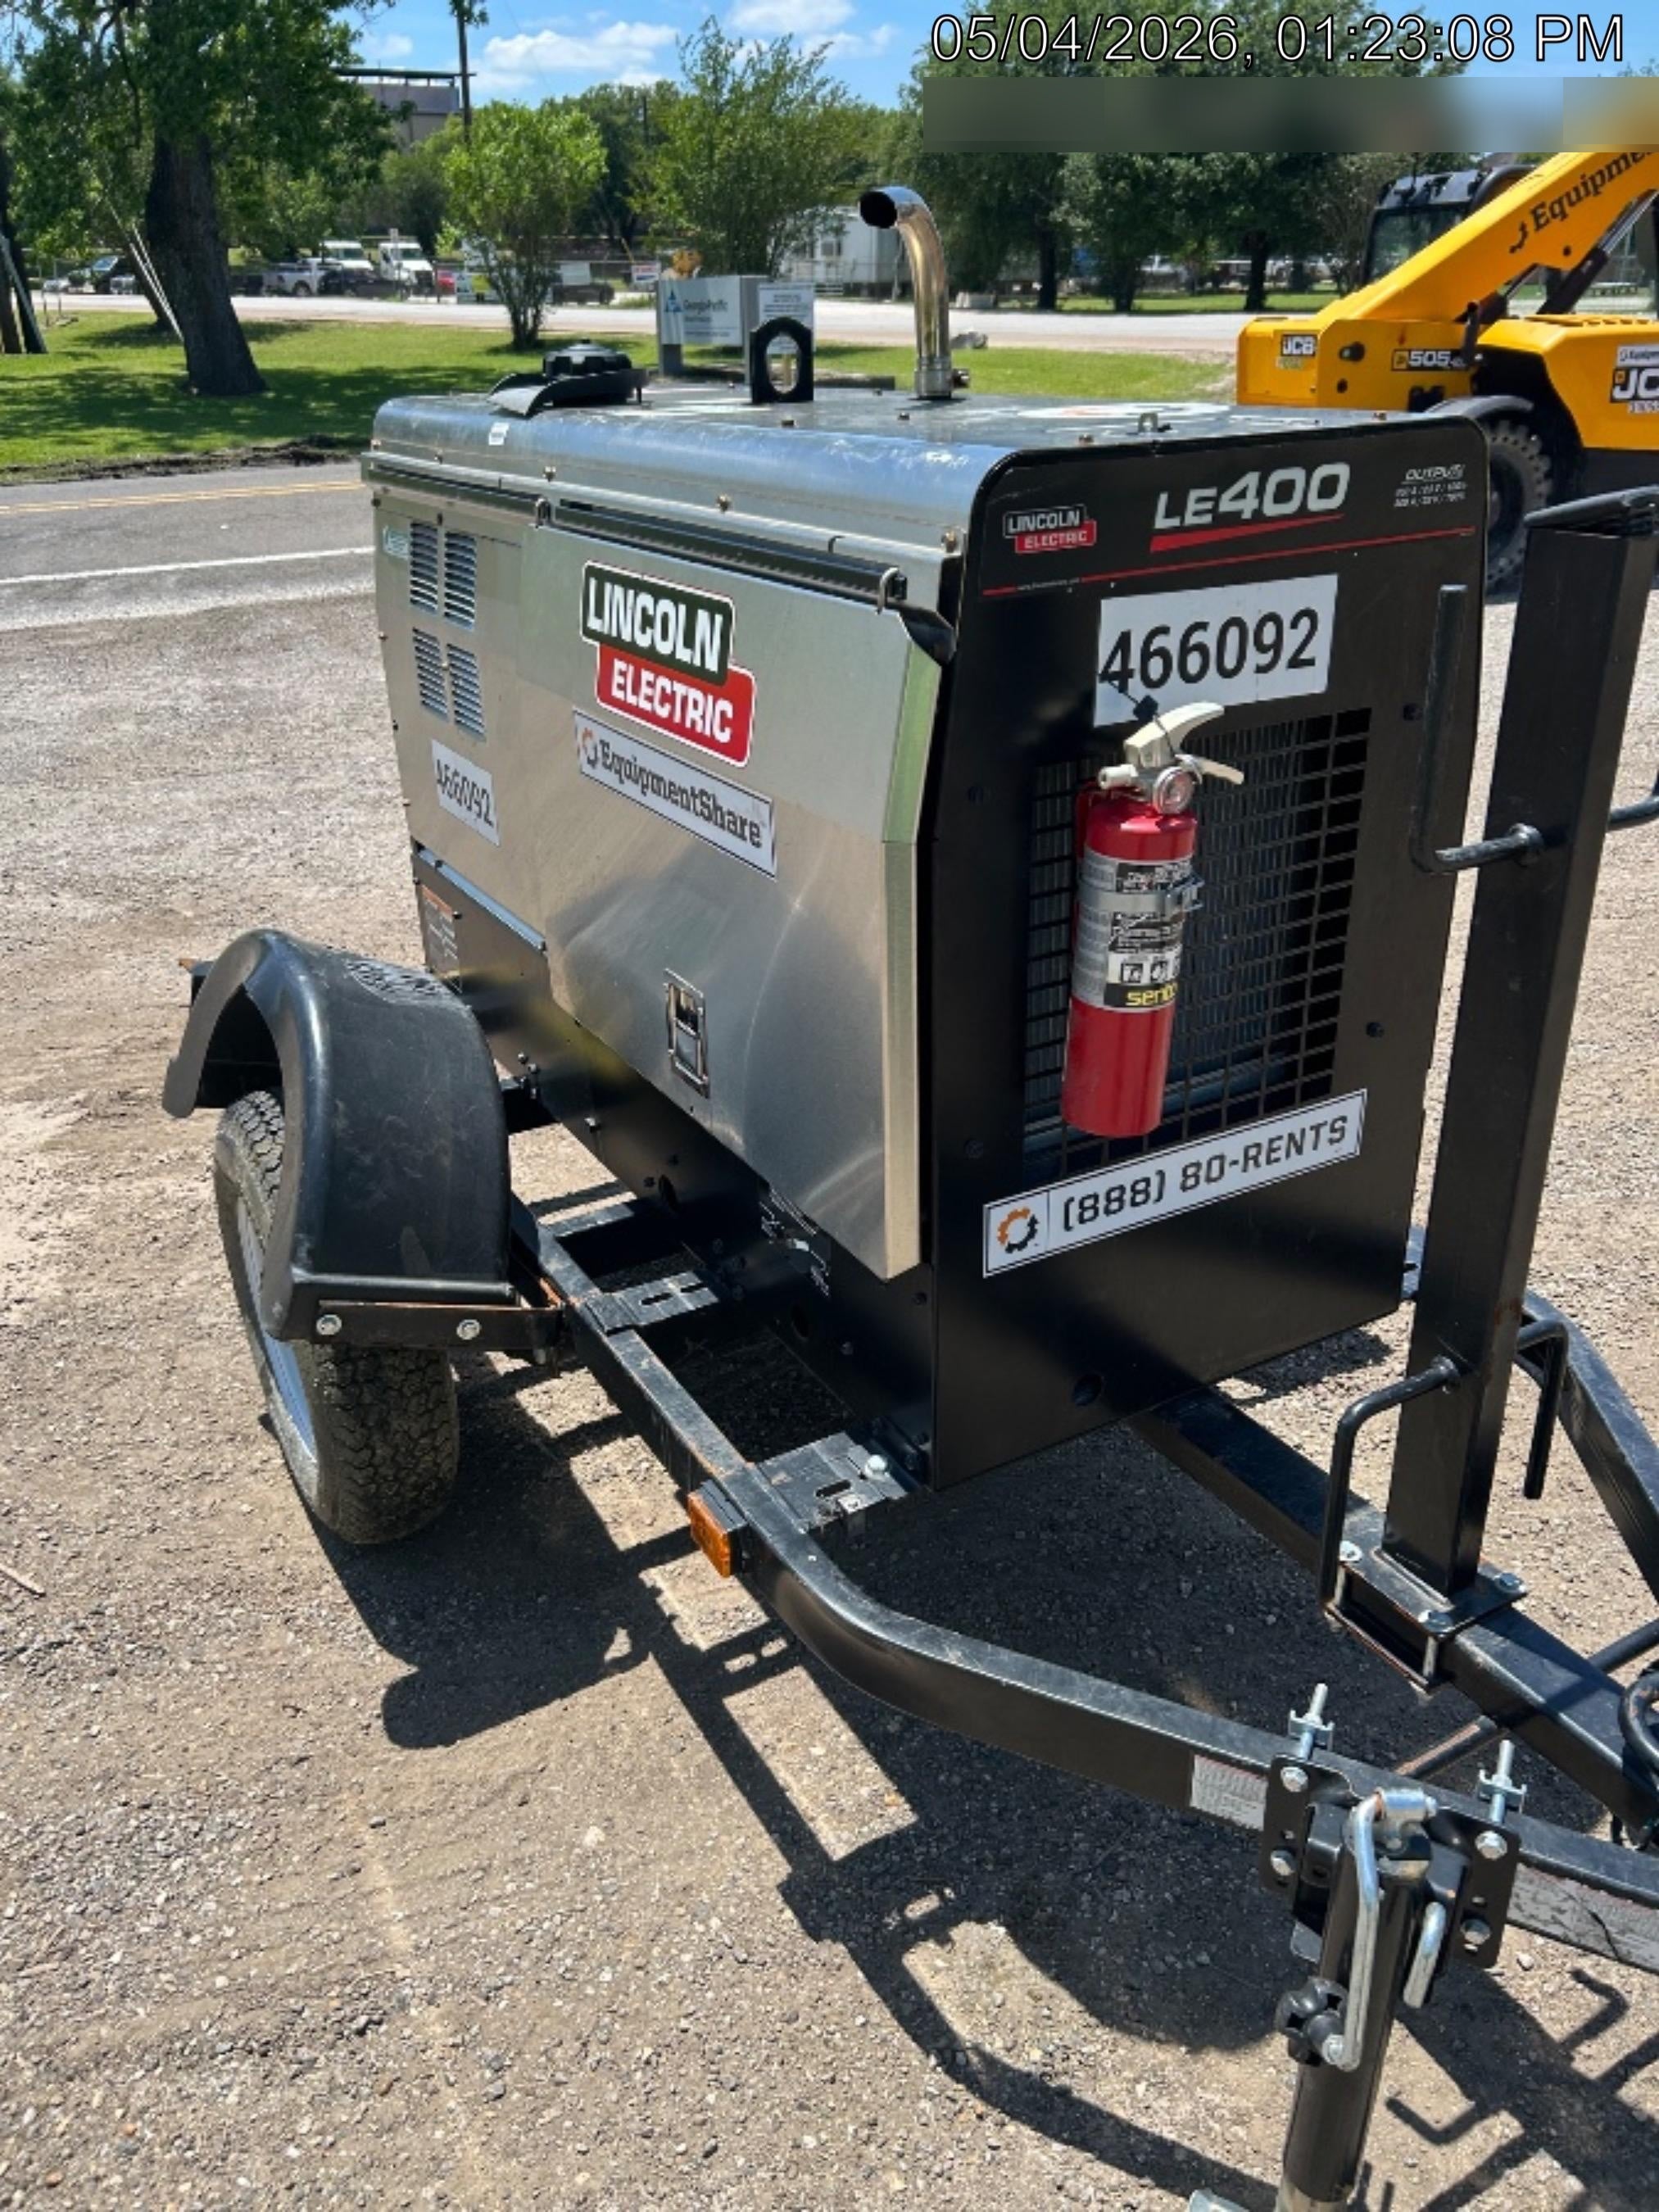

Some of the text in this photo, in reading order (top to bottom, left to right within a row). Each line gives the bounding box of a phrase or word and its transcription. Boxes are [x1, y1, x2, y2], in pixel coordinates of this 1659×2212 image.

[1283, 336, 1315, 355] JCB
[1007, 509, 1080, 533] LINCOLN
[1154, 462, 1350, 530] LE400
[1024, 531, 1087, 549] ELECTRIC
[587, 577, 723, 674] LINCOLN
[1098, 607, 1319, 694] 466092
[611, 658, 733, 743] ELECTRIC
[599, 739, 763, 849] EquipmentShare
[1063, 1115, 1349, 1231] (888) 80-RENTS
